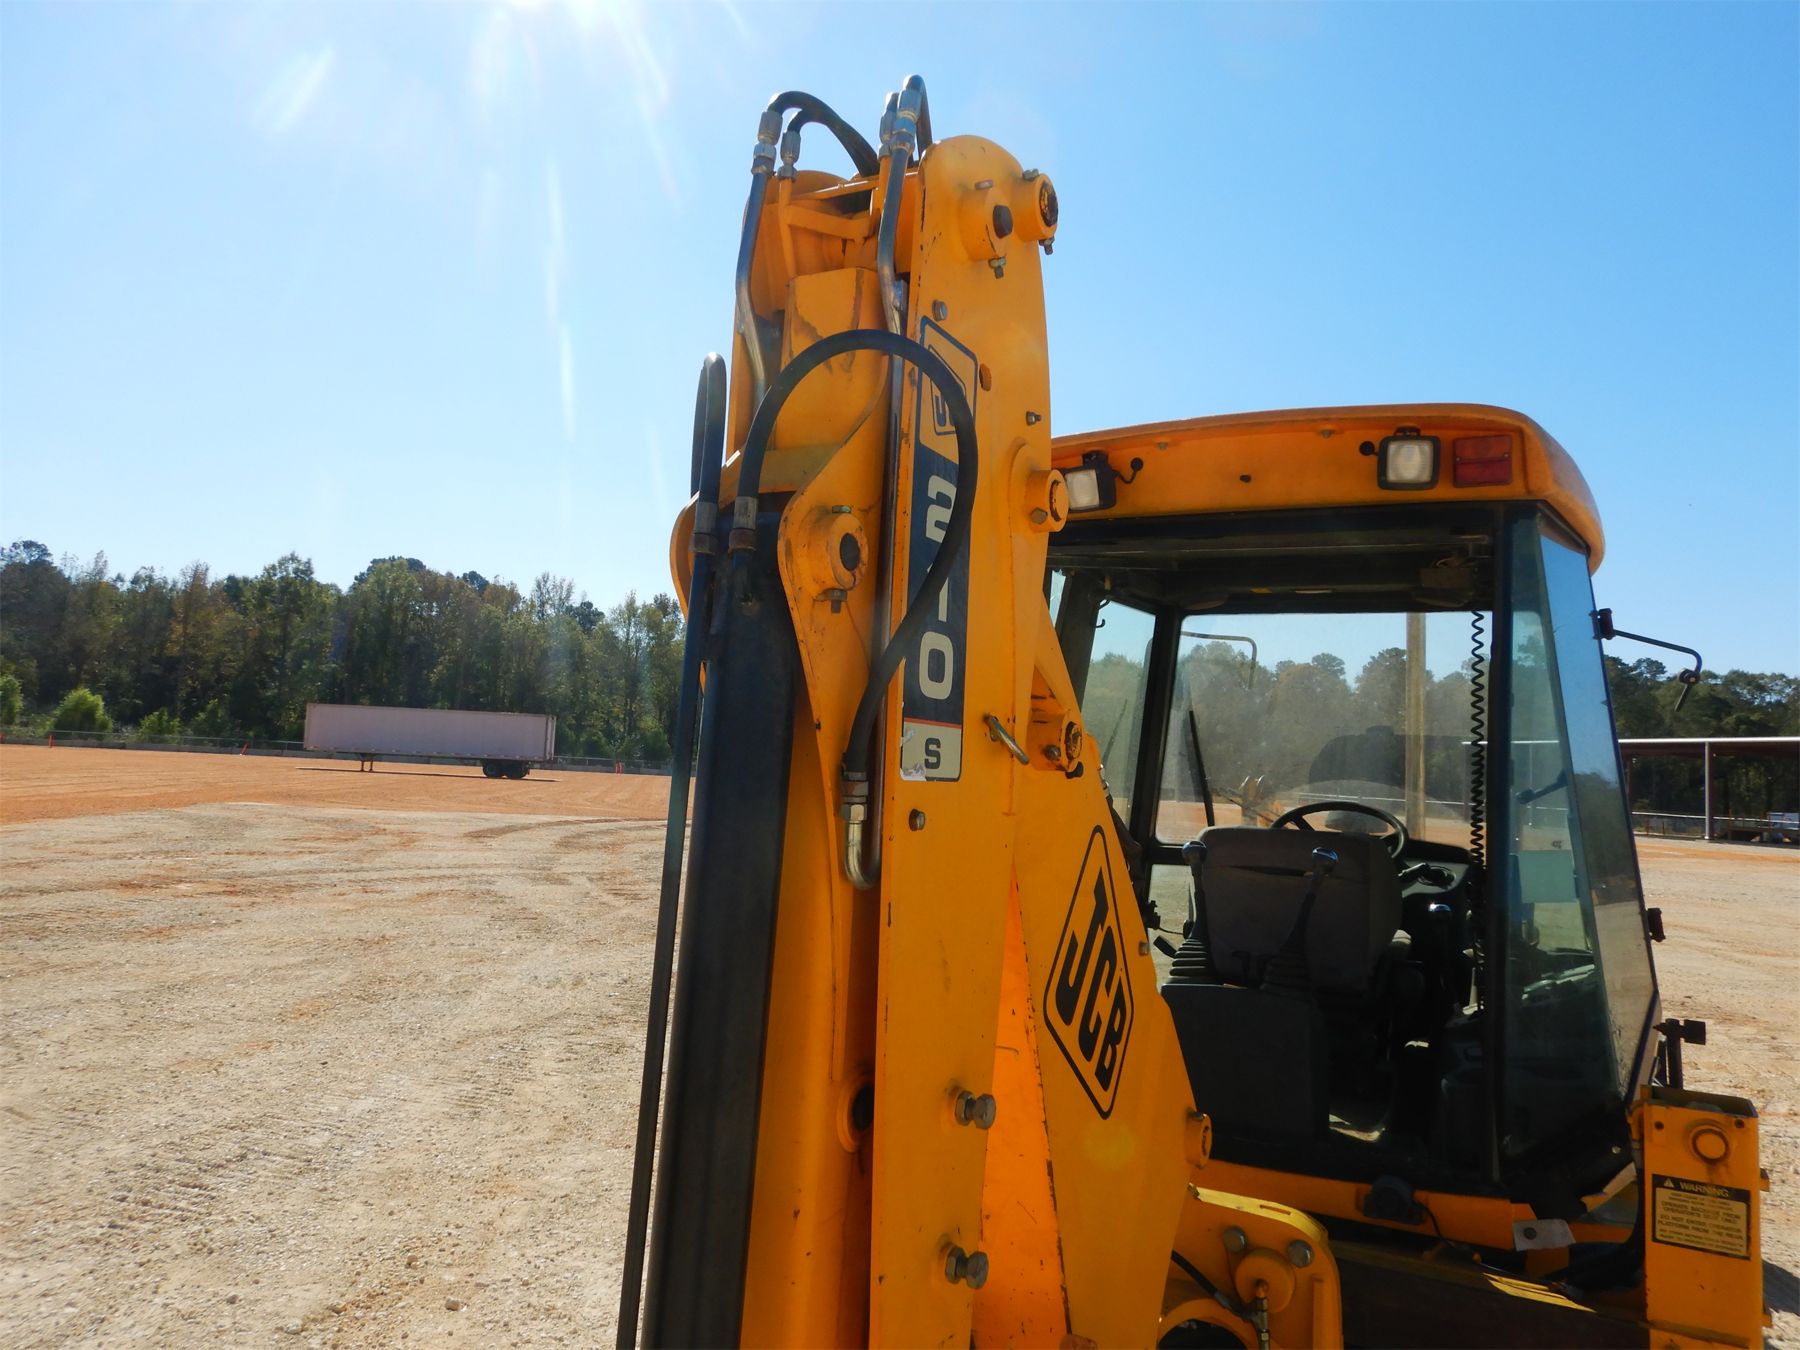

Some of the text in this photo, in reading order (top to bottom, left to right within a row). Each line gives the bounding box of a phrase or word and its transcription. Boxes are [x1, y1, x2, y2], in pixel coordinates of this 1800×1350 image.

[924, 738, 941, 770] S
[1056, 866, 1127, 1092] JCB
[1680, 1181, 1729, 1198] WARNING
